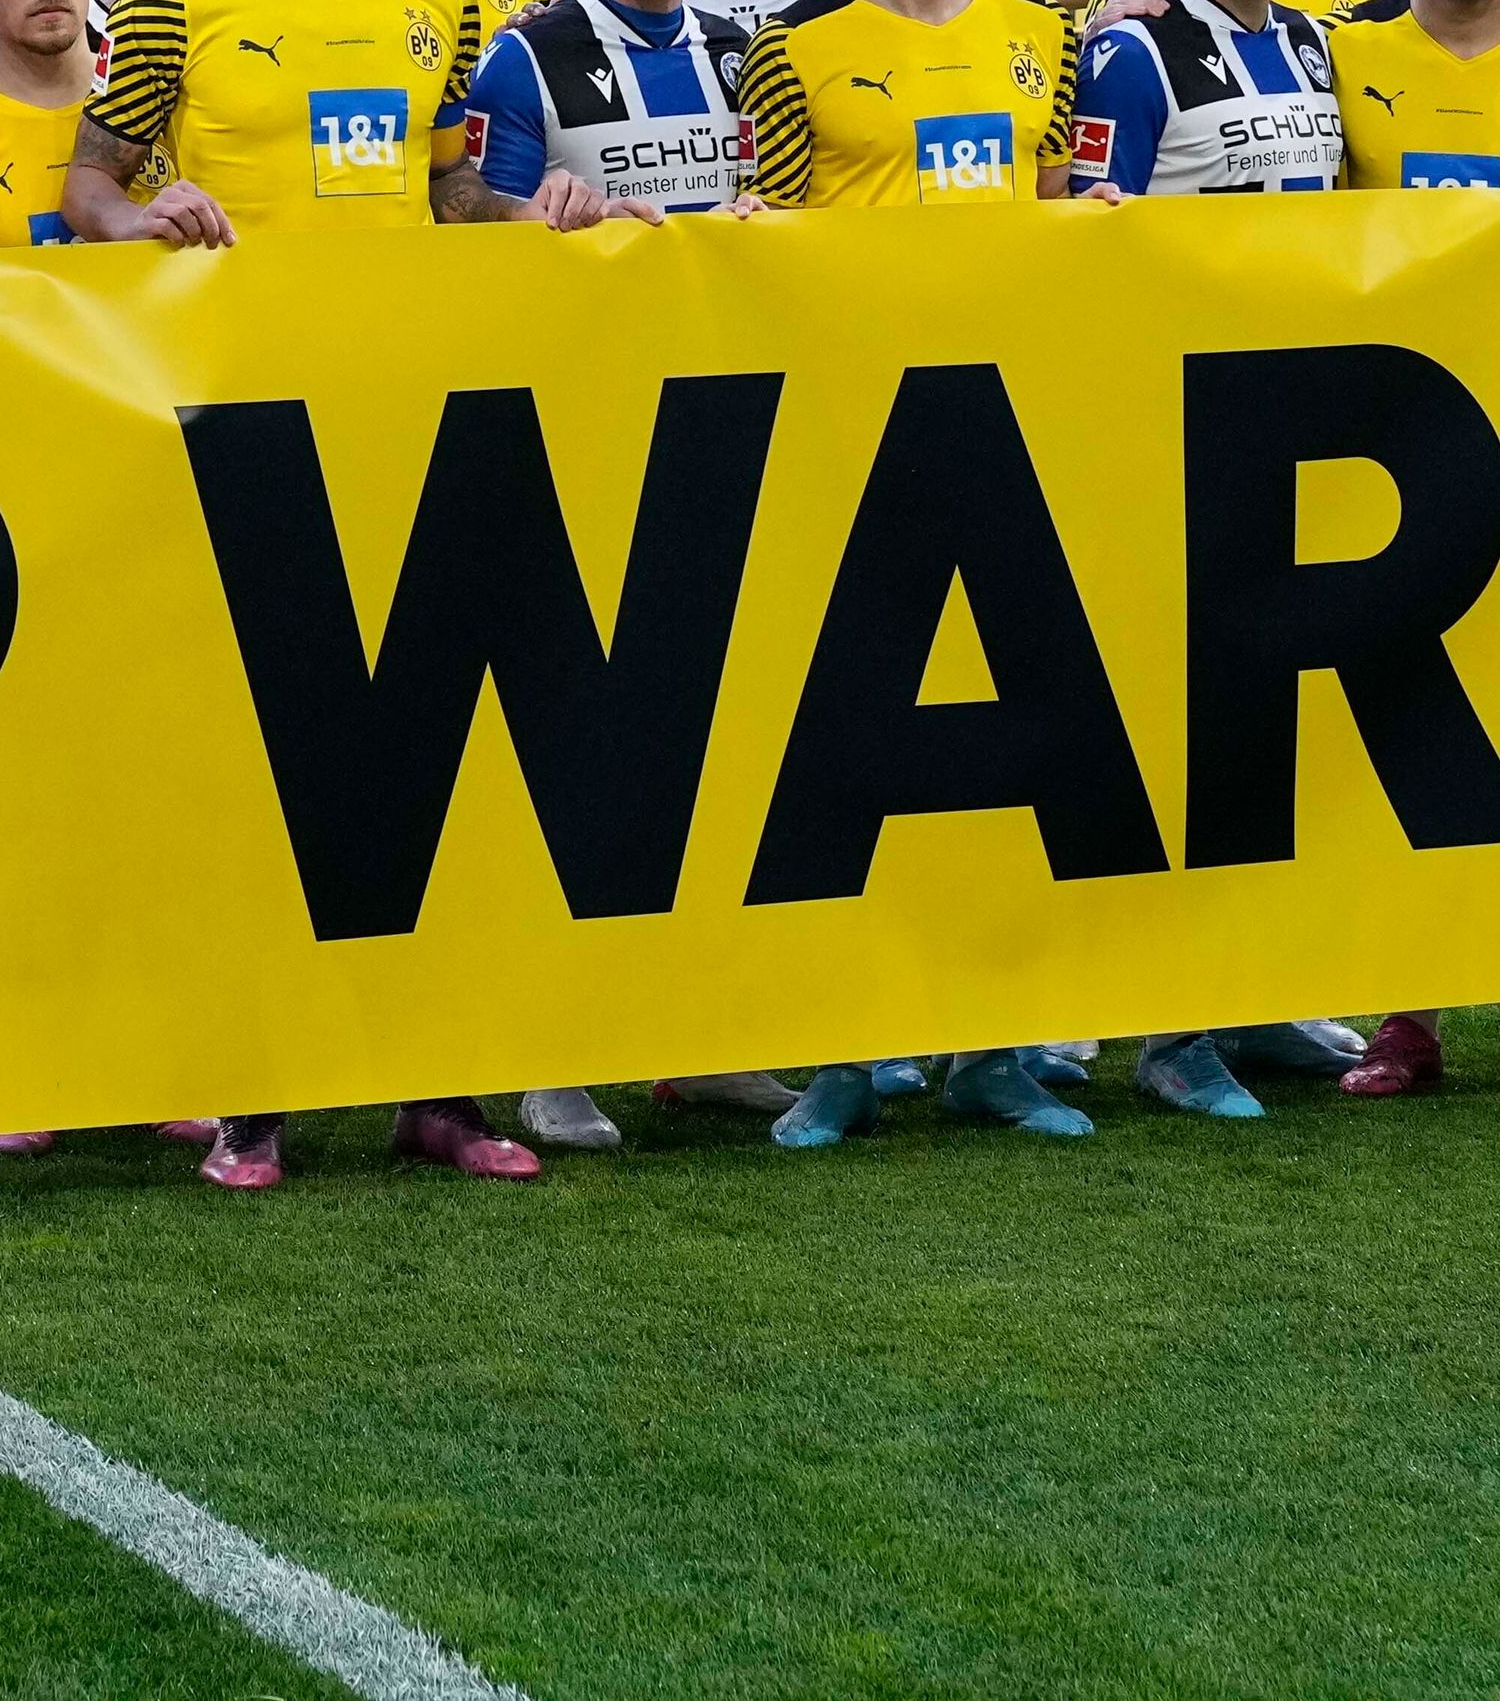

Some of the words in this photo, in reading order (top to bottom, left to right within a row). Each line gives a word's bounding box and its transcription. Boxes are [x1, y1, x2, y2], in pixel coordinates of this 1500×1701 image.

[411, 21, 439, 56] BVB
[421, 55, 434, 67] 09
[1014, 57, 1044, 85] BVB
[1027, 84, 1041, 95] 09
[321, 114, 396, 167] 1&1
[599, 128, 740, 173] SCHÜC
[924, 137, 1003, 191] 1&1
[1071, 162, 1105, 173] NDESLIGA
[1227, 152, 1288, 172] Fenster
[1294, 146, 1318, 165] und
[146, 174, 160, 185] 09
[606, 175, 679, 199] Fenster
[684, 170, 719, 192] und
